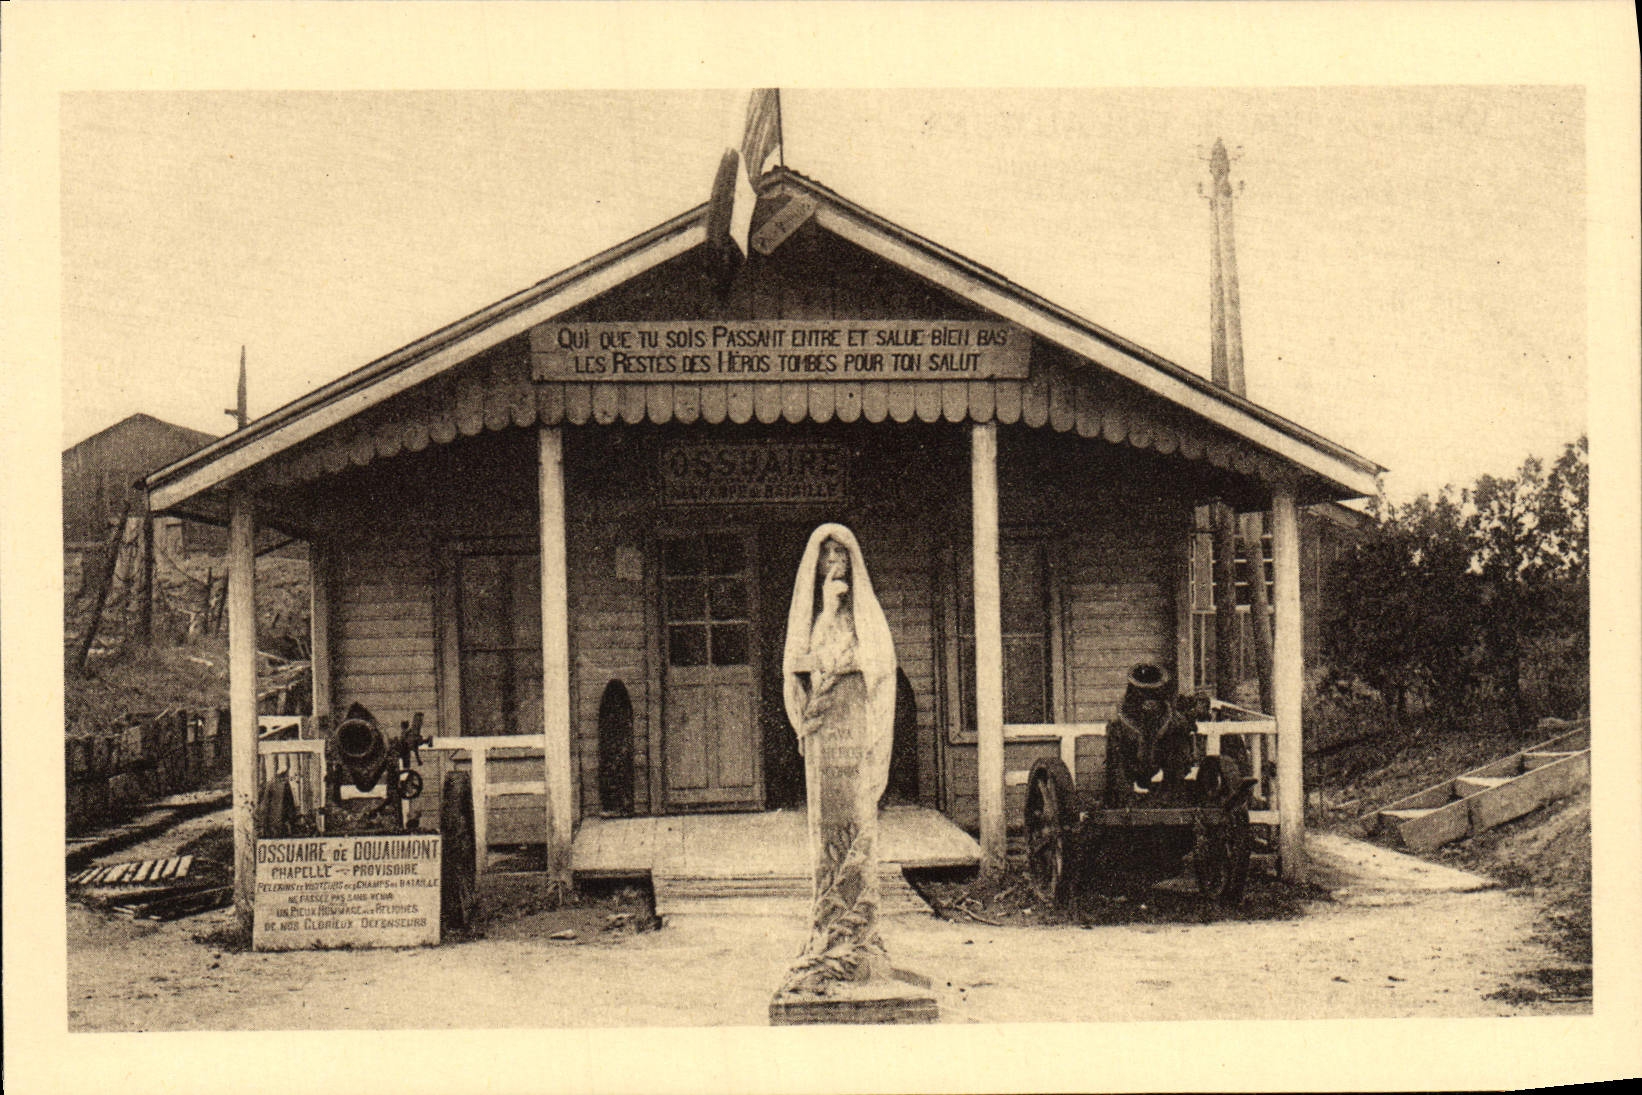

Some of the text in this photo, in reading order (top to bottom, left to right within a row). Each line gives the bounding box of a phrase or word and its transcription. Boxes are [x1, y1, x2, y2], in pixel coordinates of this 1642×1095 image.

[557, 327, 590, 350] QUI
[600, 331, 632, 350] QUE
[638, 331, 658, 348] TU
[666, 329, 706, 348] SOIS
[712, 325, 786, 348] PASSANT
[792, 330, 841, 347] ENTRE
[848, 329, 869, 346] ET
[876, 329, 924, 346] SALUE
[931, 327, 969, 346] BIEN
[575, 355, 606, 373] LES
[613, 352, 676, 373] RESTES
[682, 354, 710, 373] DES
[845, 353, 883, 372] POUR
[892, 353, 921, 372] TON
[928, 353, 981, 372] SALUT
[258, 839, 439, 864] OSSUAIRE DE DOUAUMONT
[271, 863, 418, 879] CHAPELLE PROVISOIRE
[356, 880, 390, 890] CHAMPS
[400, 879, 439, 888] BATAILLE
[264, 921, 276, 931] DE
